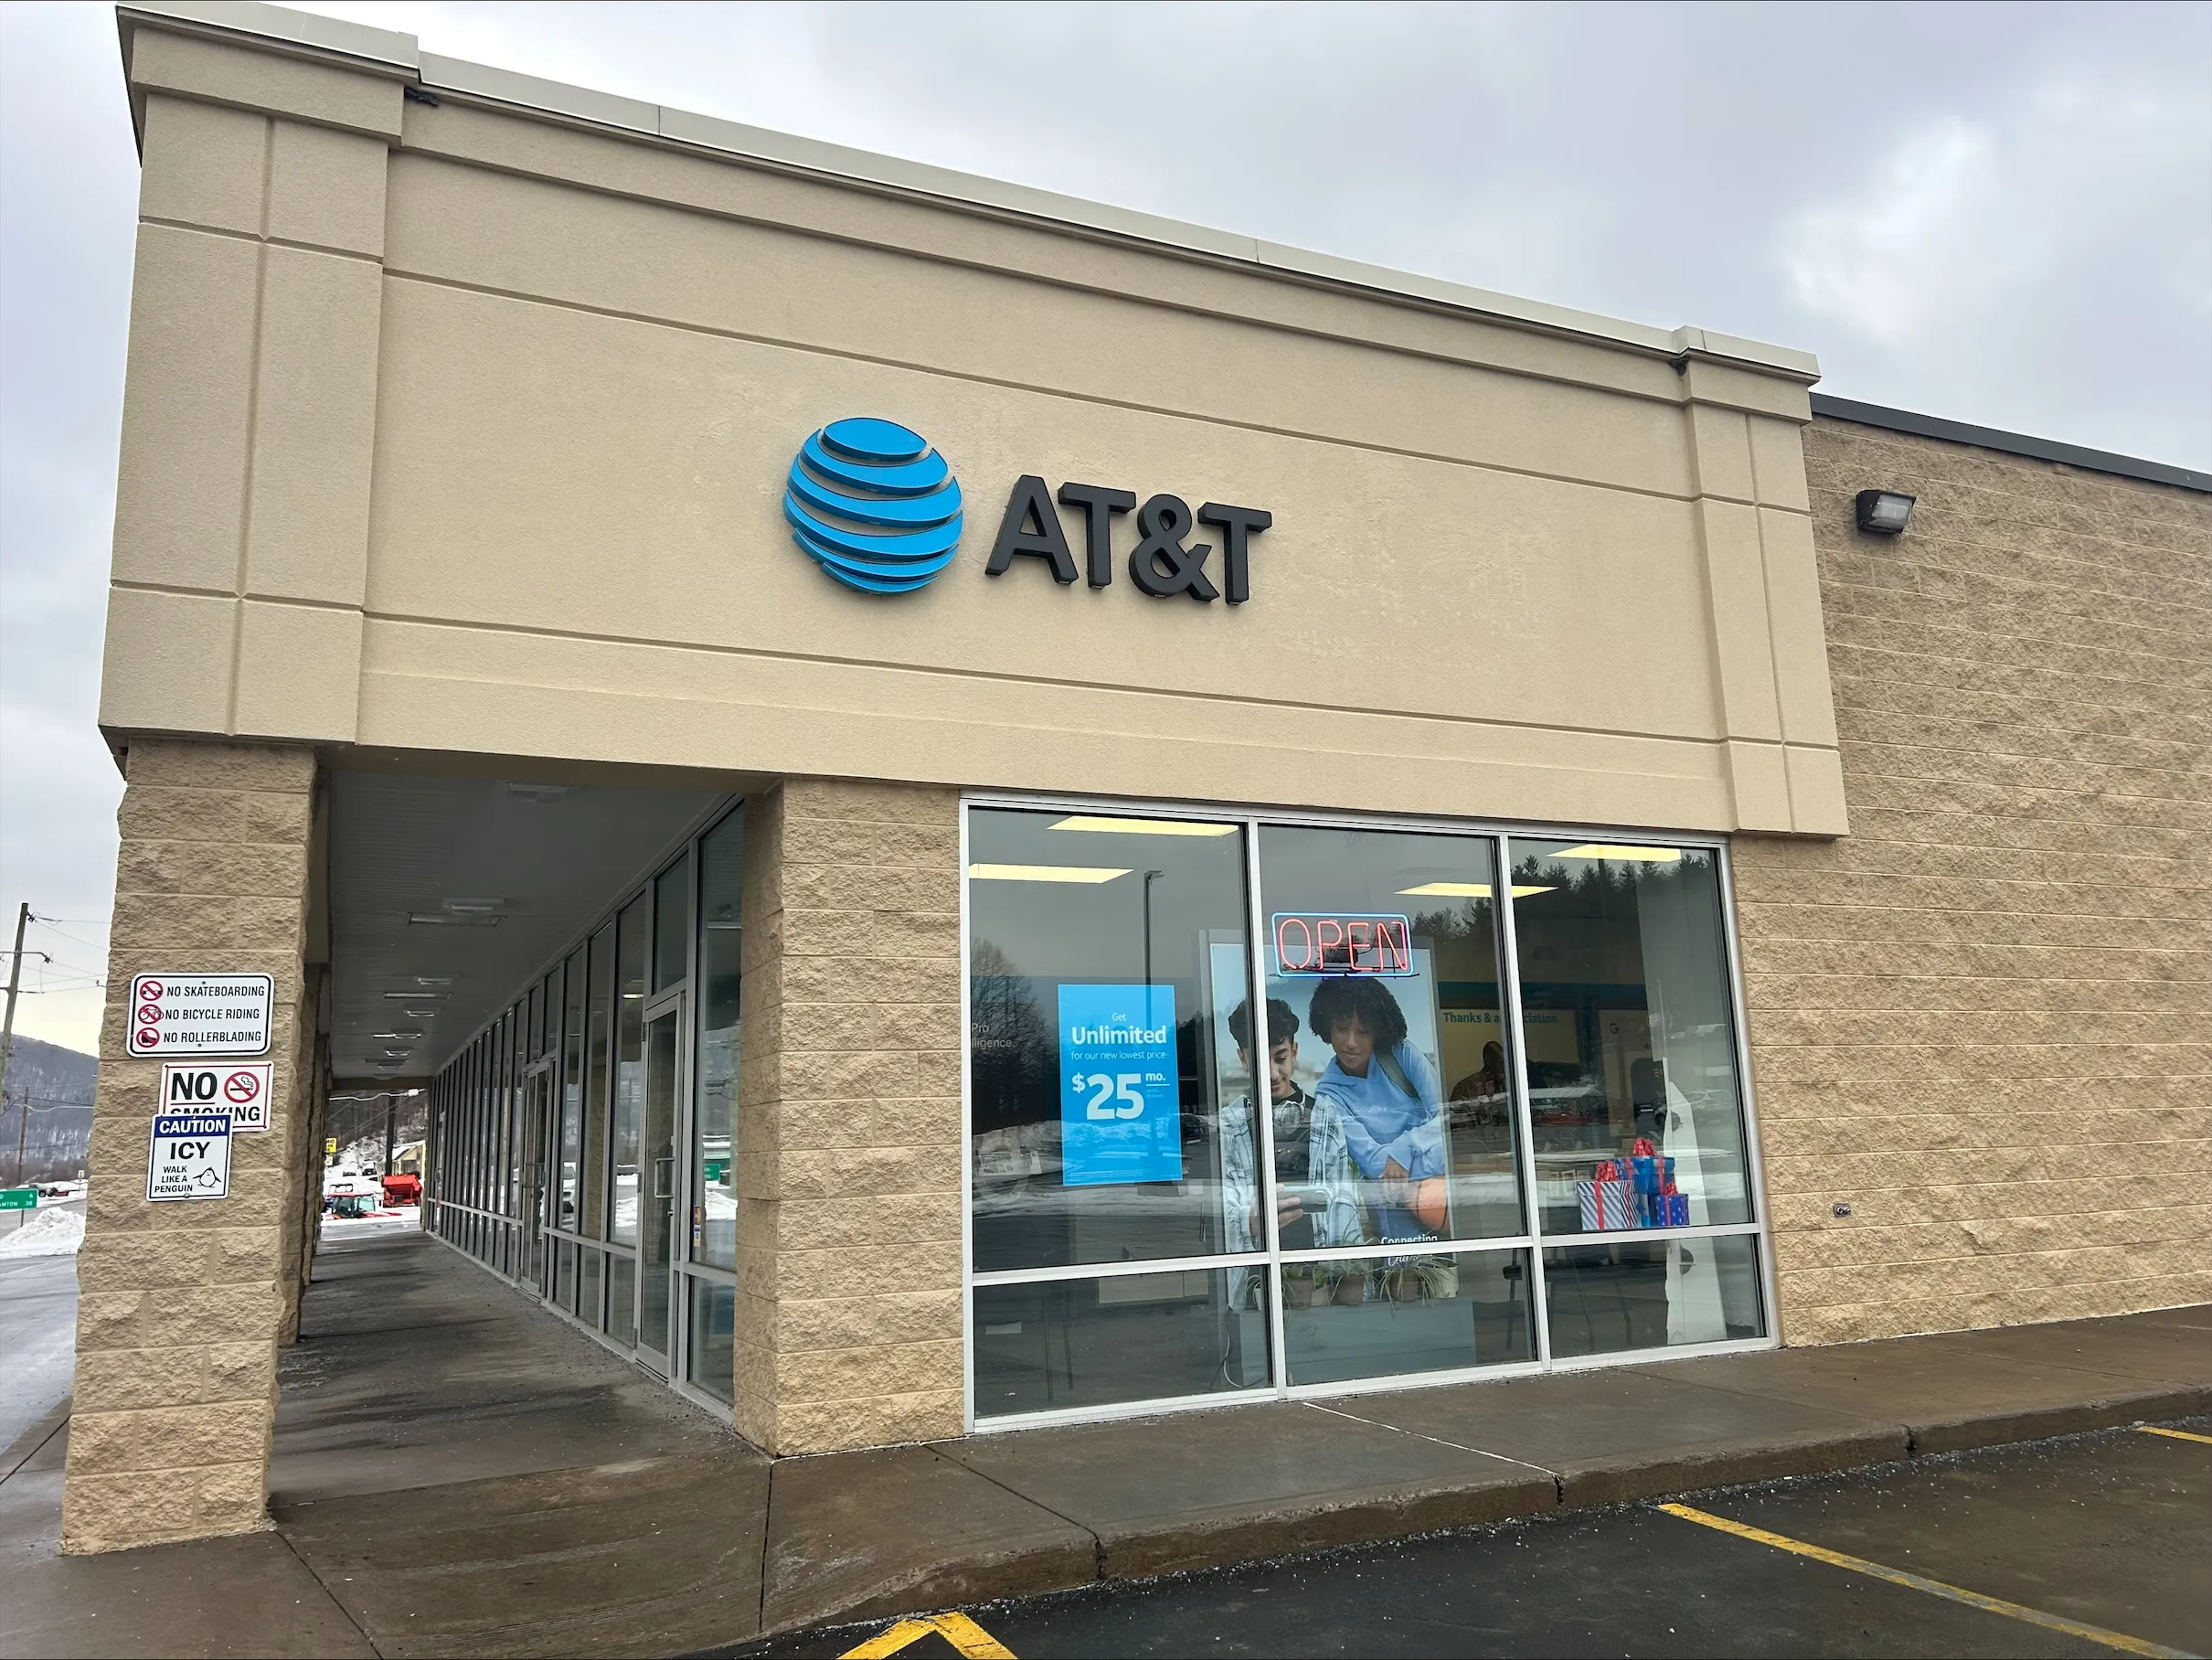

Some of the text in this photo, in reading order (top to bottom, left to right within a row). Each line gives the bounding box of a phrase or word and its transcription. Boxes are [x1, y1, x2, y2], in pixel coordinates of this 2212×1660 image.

[985, 474, 1272, 605] AT&T
[1279, 918, 1409, 972] OPEN
[166, 985, 265, 996] NO SKATEBOARDING
[165, 1008, 260, 1019] NO BICYCLE RIDING
[1111, 1012, 1127, 1021] Get
[1442, 1012, 1482, 1024] Thanks
[1484, 1012, 1492, 1023] &
[972, 1022, 990, 1033] Pro
[163, 1031, 261, 1043] NO ROLLERBLADING
[1071, 1025, 1167, 1045] Unlimited
[1070, 1050, 1083, 1060] for
[1085, 1052, 1099, 1060] our
[1100, 1051, 1118, 1059] new
[1119, 1050, 1145, 1059] lowest
[170, 1071, 218, 1101] NO
[1071, 1072, 1166, 1121] $25 mo.
[159, 1119, 227, 1133] CAUTION
[170, 1141, 211, 1160] ICY
[163, 1165, 187, 1174] WALK
[181, 1175, 187, 1183] A
[154, 1184, 193, 1193] PENGUIN
